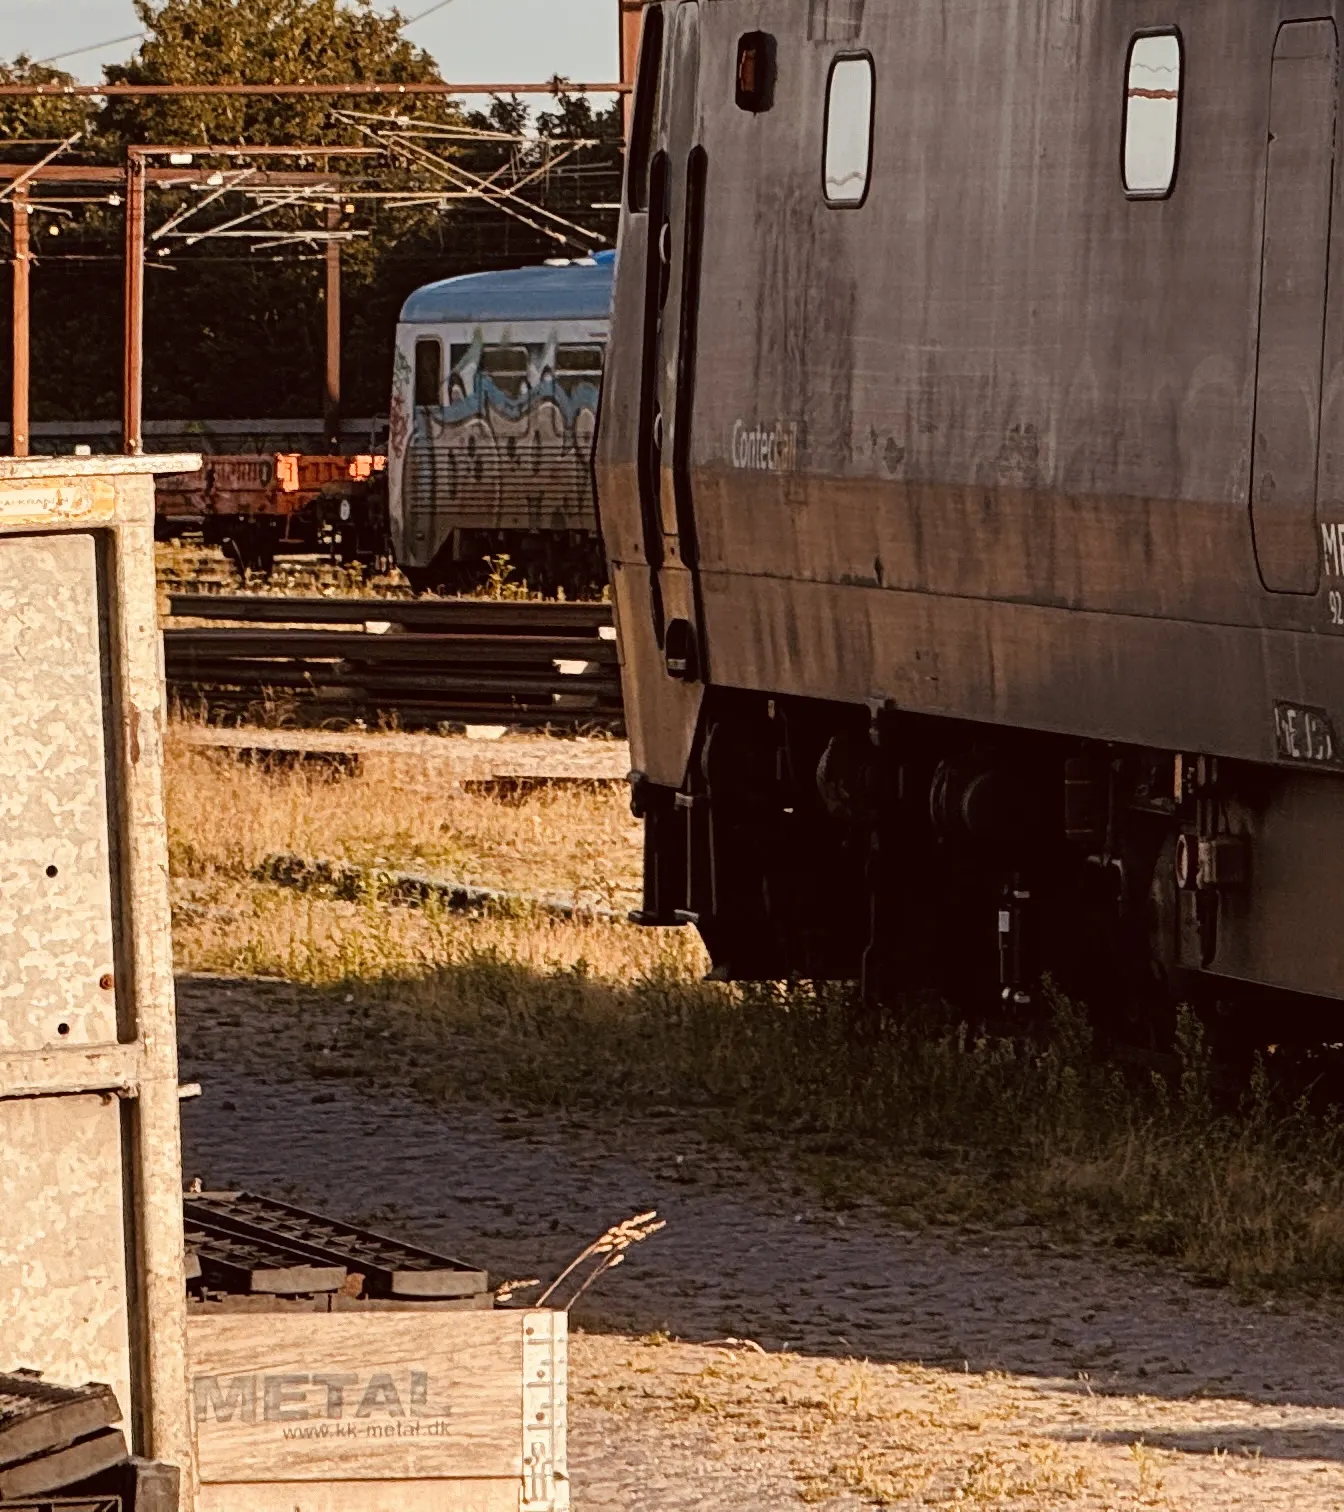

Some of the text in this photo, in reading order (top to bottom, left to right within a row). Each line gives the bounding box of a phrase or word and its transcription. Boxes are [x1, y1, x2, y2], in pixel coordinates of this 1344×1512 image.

[731, 419, 798, 472] ContecRail
[1328, 591, 1344, 625] 92
[193, 1371, 451, 1422] METAL
[282, 1419, 452, 1440] www.kk-metal.dk
